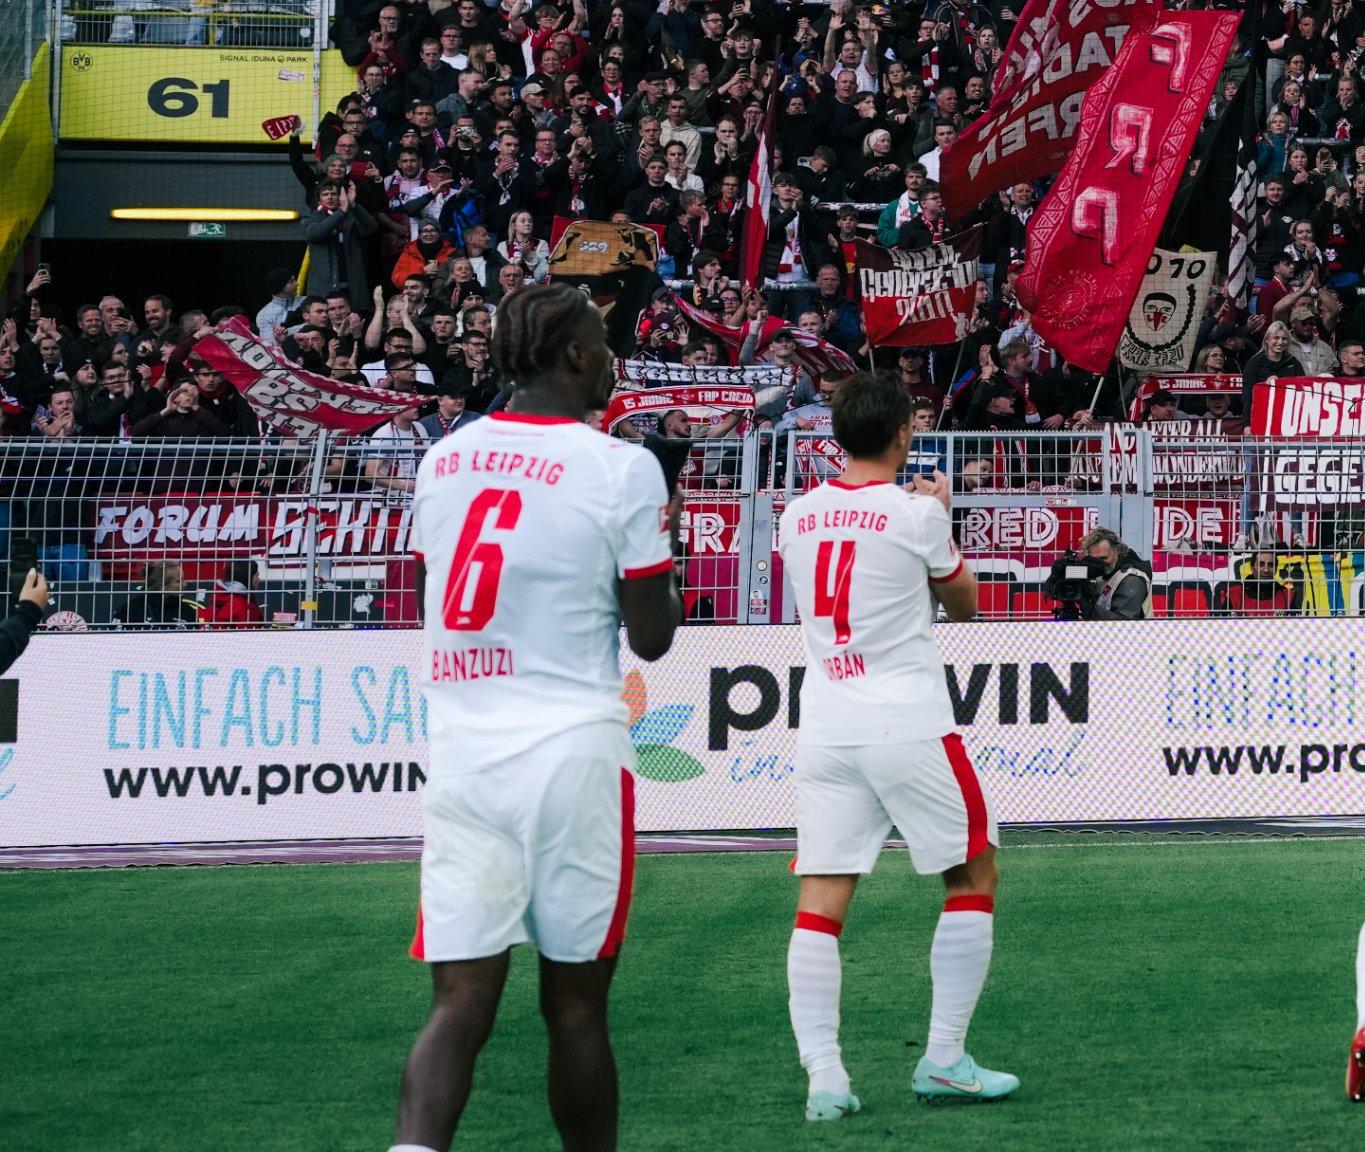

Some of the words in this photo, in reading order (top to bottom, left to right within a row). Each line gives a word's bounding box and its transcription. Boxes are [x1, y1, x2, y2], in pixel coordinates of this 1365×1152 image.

[219, 54, 250, 63] SIGNAL
[251, 55, 277, 63] IDUNA
[147, 77, 230, 118] 61
[435, 452, 461, 479] RB
[471, 450, 566, 486] LEIPZIG
[95, 503, 260, 546] FORUM
[797, 515, 817, 535] RB
[823, 510, 889, 532] LEIPZIG
[443, 488, 522, 632] 6
[814, 540, 855, 645] 4
[432, 648, 514, 682] BANZUZI
[107, 667, 322, 751] EINFACH
